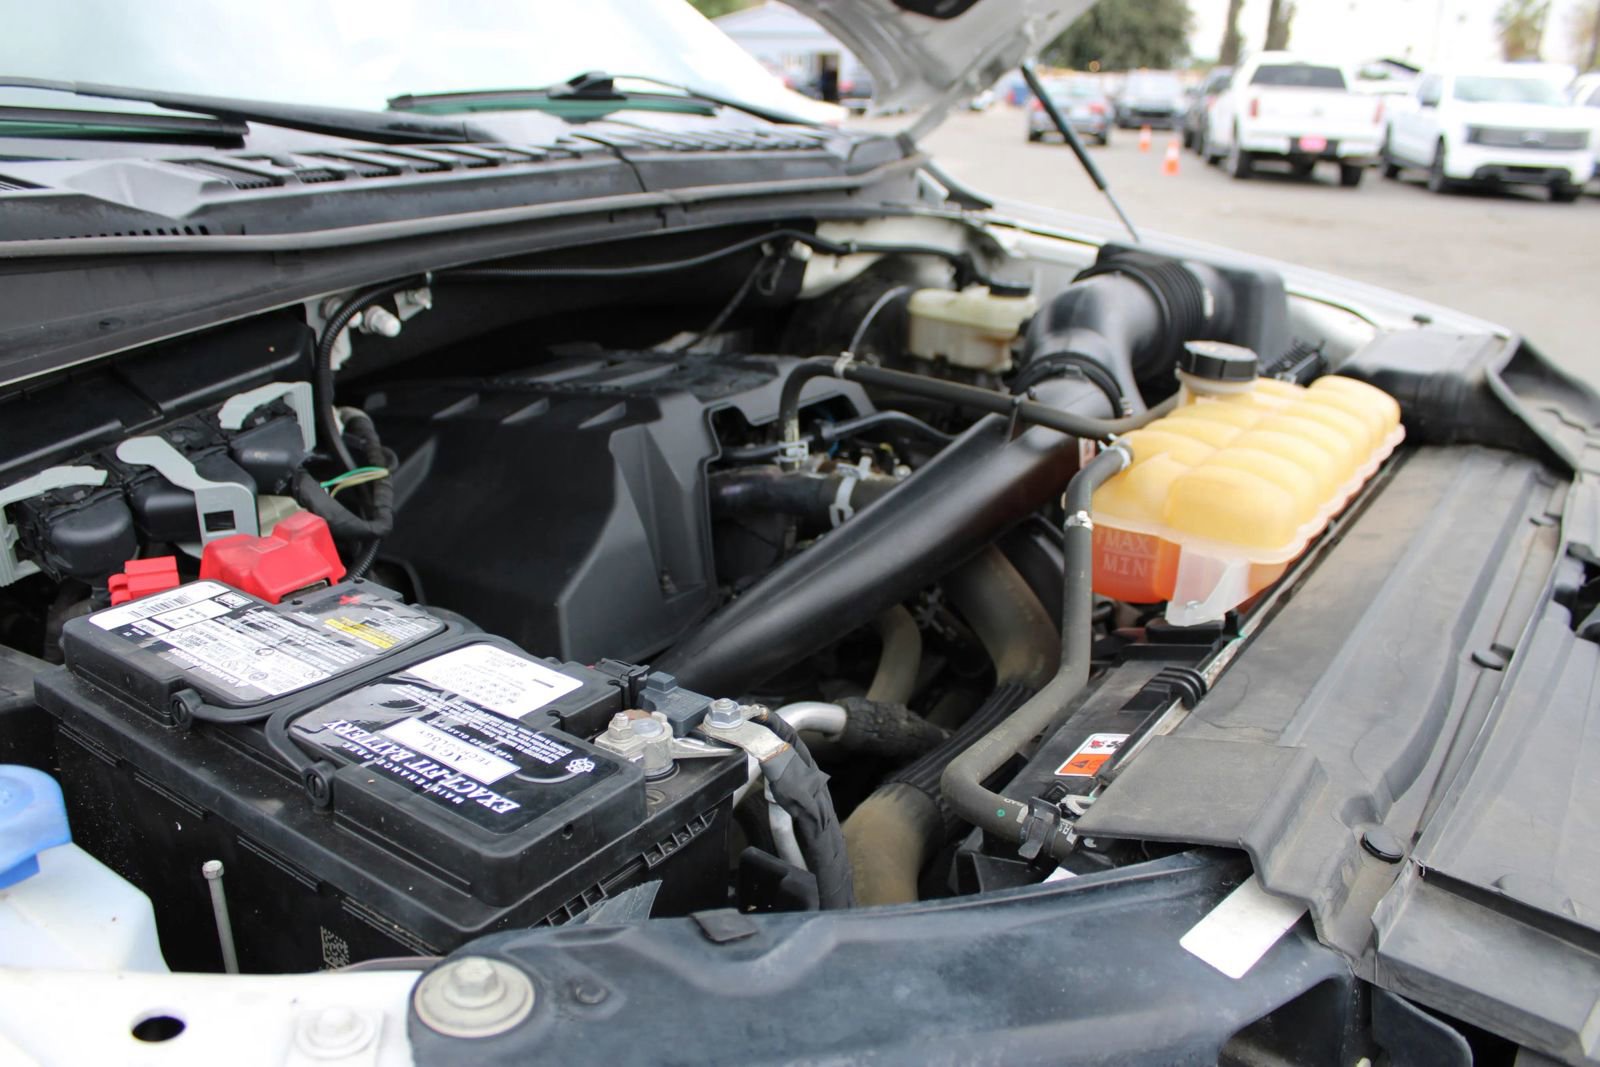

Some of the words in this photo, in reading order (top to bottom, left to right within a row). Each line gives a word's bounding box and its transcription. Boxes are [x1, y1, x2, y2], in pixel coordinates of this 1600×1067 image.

[1104, 530, 1150, 554] MAX
[1104, 552, 1148, 578] MIN
[323, 719, 416, 762] BATTERY
[419, 729, 492, 766] TECHNOLOGY
[423, 742, 468, 762] AGM
[403, 759, 521, 814] EXACT-FIT
